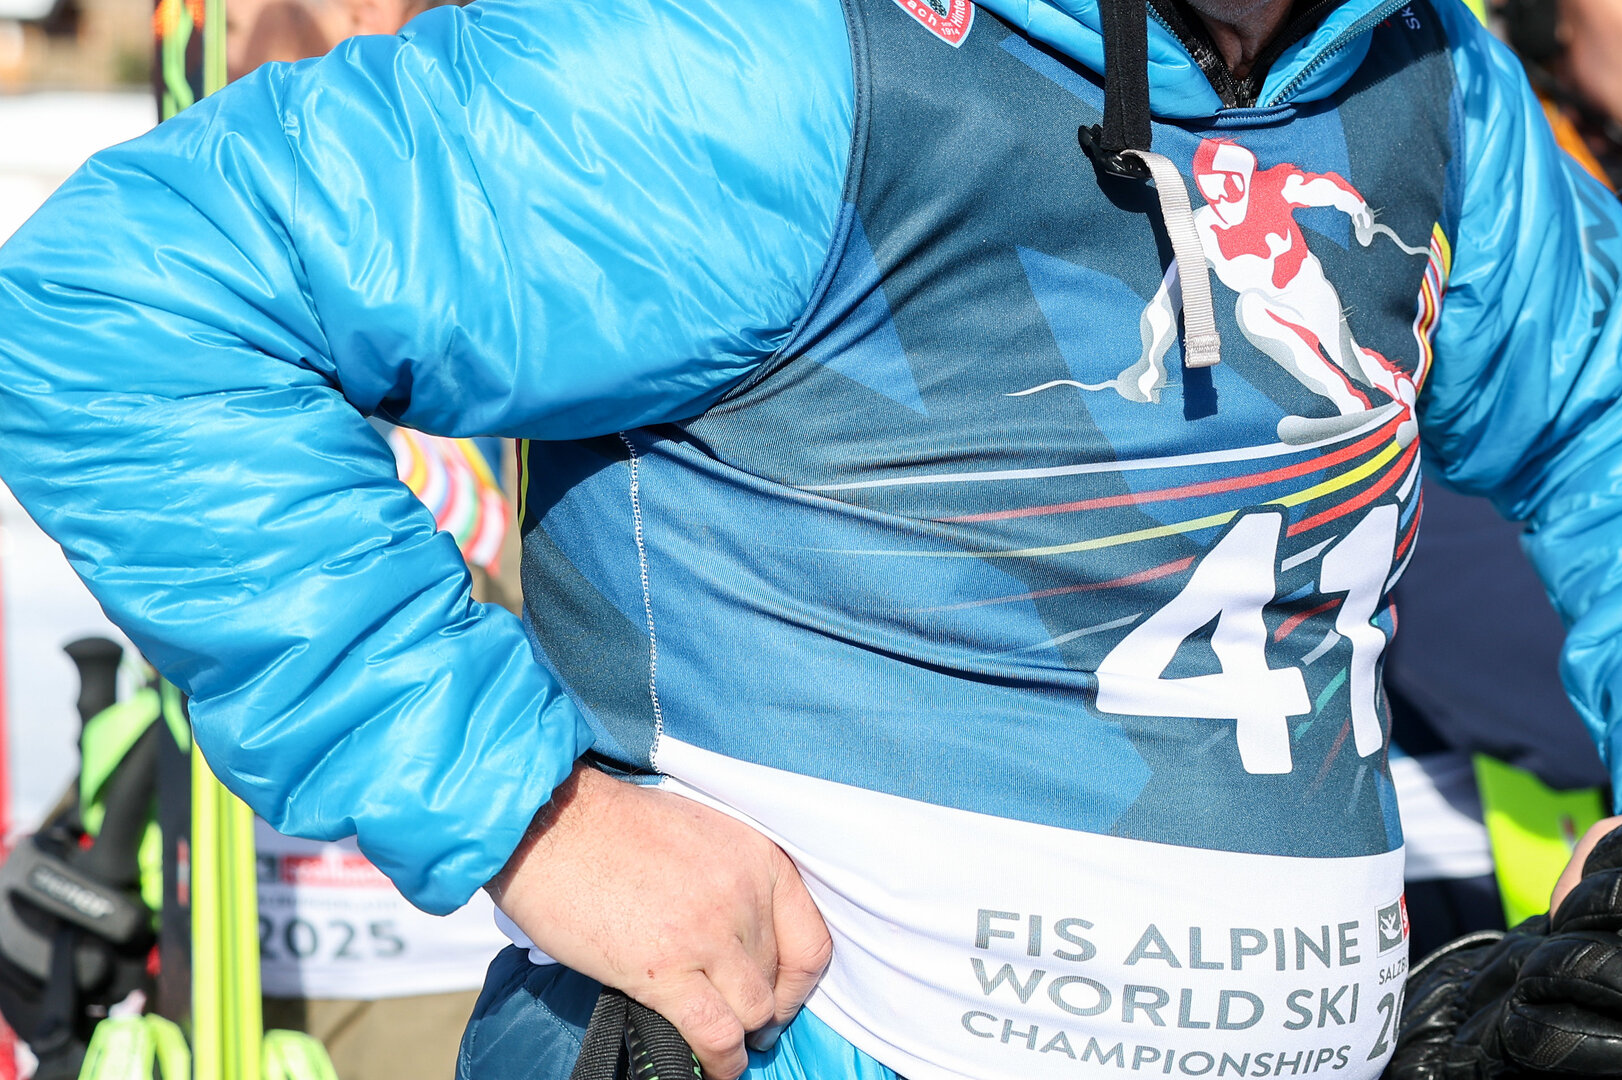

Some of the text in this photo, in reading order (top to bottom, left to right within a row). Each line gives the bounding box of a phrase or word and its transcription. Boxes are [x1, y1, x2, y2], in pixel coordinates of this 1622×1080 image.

[1095, 504, 1400, 775] 41
[258, 915, 405, 961] 2025
[974, 908, 1097, 962] FIS
[1123, 920, 1361, 971] ALPINE
[970, 957, 1360, 1031] WORLD SKI
[1378, 956, 1408, 986] SALZB
[960, 1010, 1352, 1078] CHAMPIONSHIPS
